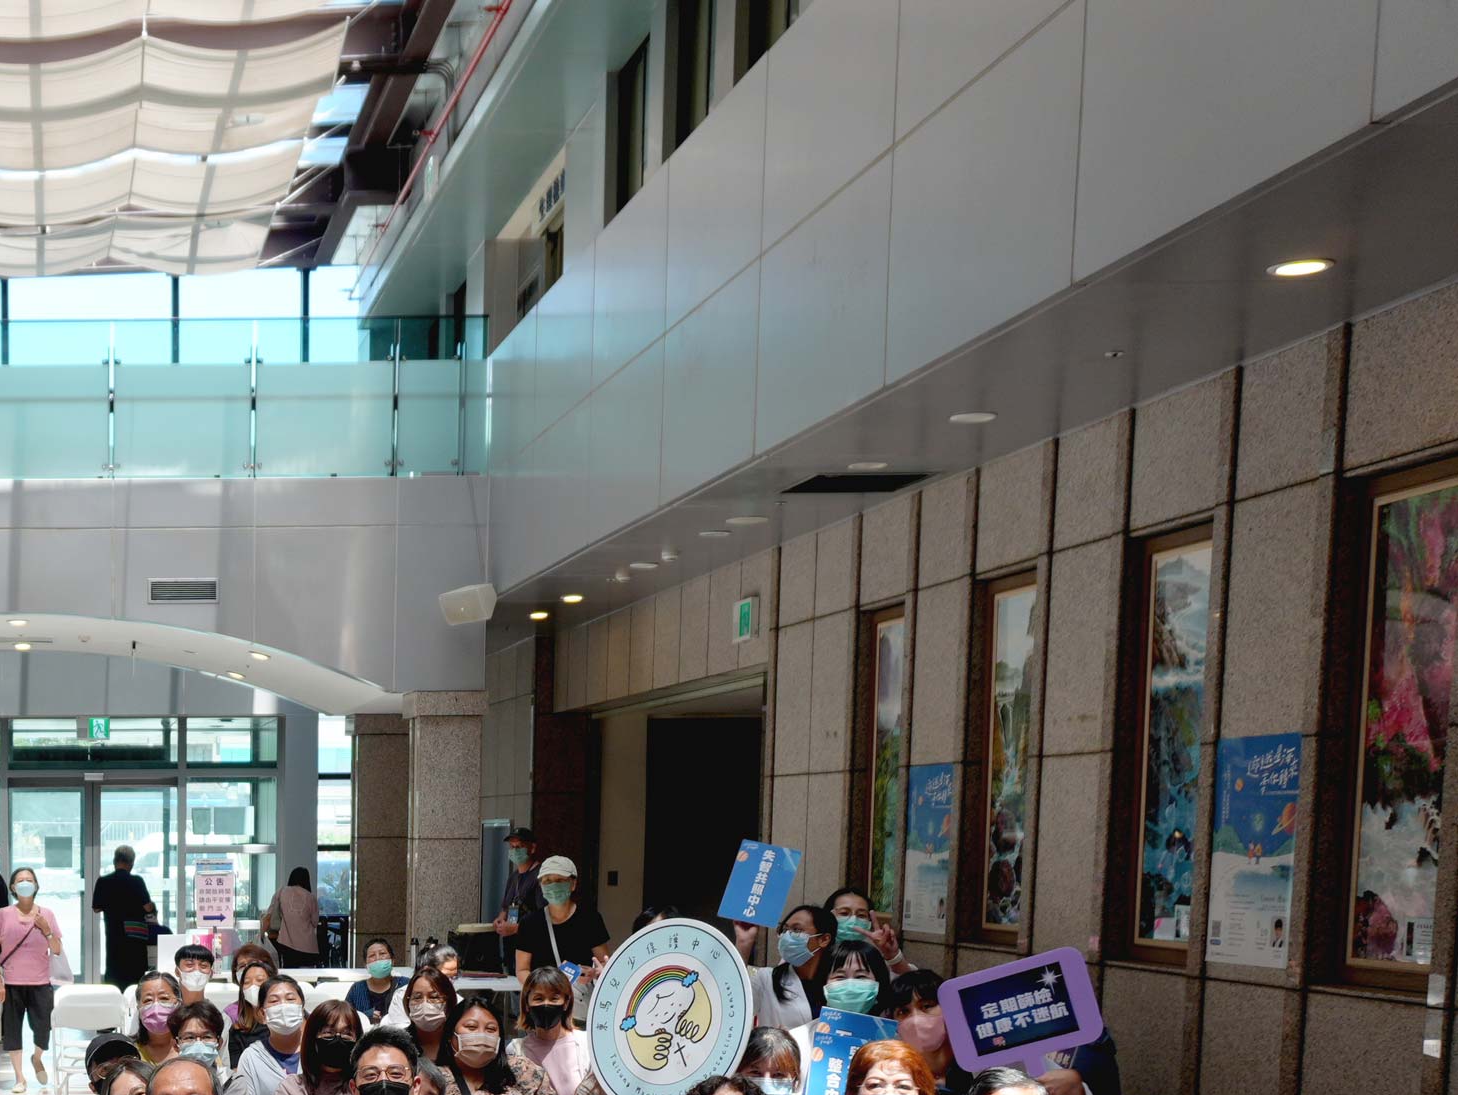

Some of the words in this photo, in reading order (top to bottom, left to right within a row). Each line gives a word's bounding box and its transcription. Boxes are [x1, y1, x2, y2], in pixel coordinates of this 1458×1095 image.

[205, 878, 224, 886] 公告
[743, 850, 776, 917] 失智共照中心
[976, 1001, 1069, 1040] 健康不迷航
[981, 987, 1054, 1019] 定期篩檢
